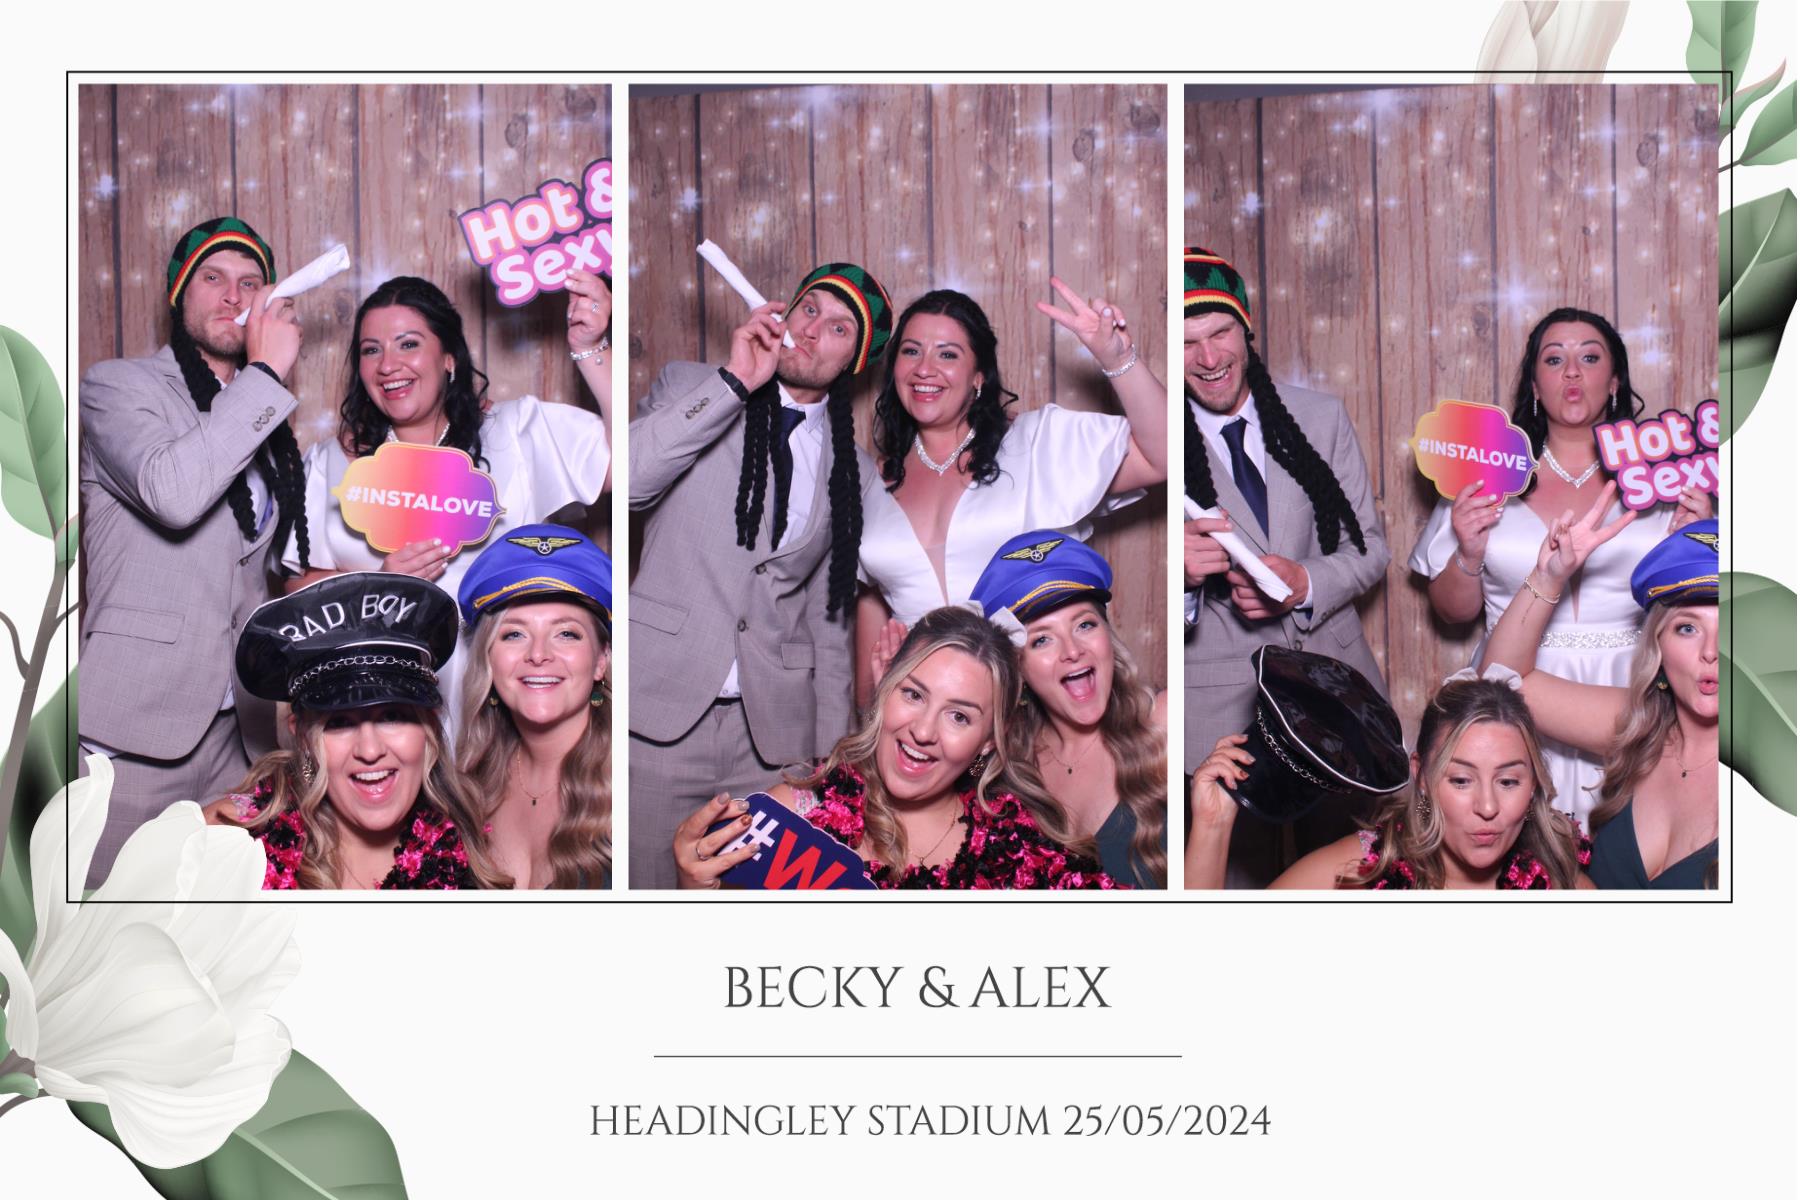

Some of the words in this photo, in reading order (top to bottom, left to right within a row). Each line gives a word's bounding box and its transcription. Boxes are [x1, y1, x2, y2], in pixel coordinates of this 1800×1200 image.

[468, 188, 578, 259] Hot
[590, 167, 612, 213] &
[1418, 438, 1528, 472] #INSTALOVE
[1601, 416, 1692, 466] Hot
[345, 485, 493, 518] #INSTALOVE
[278, 601, 346, 643] BAD
[360, 594, 417, 624] BOY
[716, 810, 848, 890] #W
